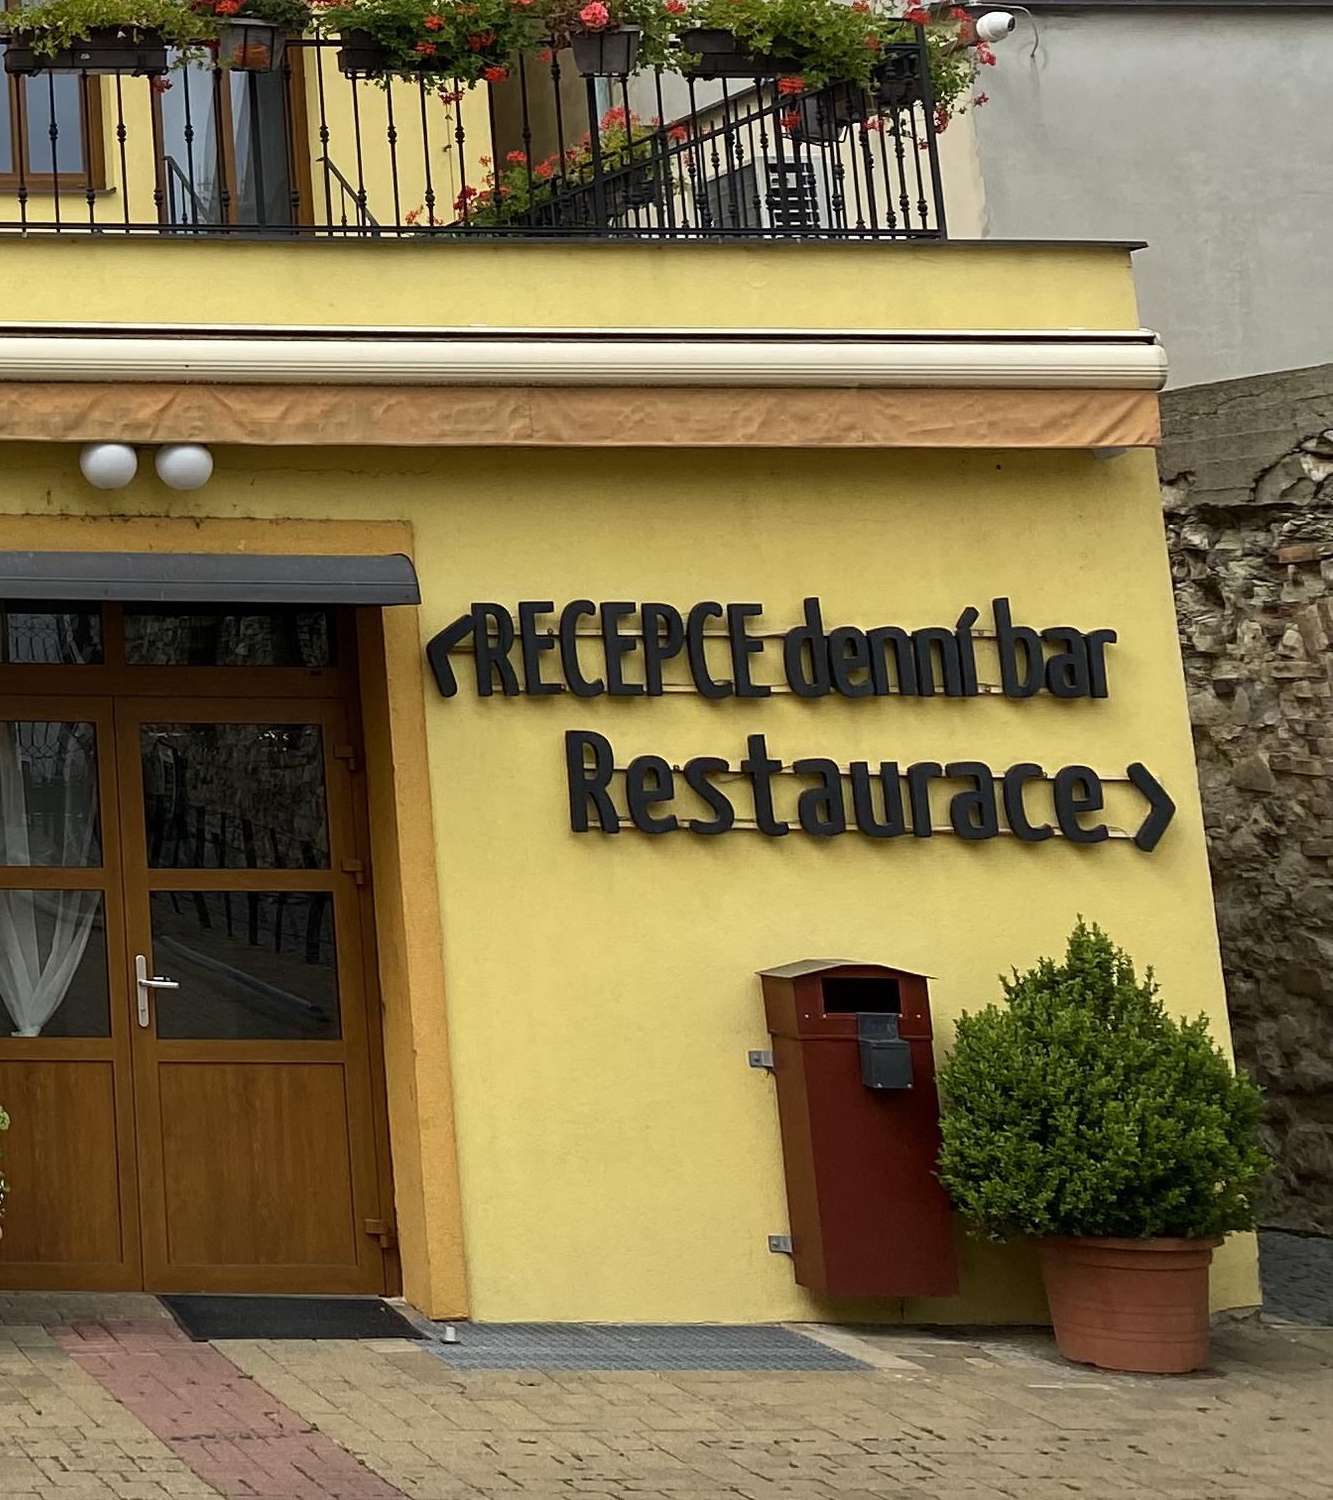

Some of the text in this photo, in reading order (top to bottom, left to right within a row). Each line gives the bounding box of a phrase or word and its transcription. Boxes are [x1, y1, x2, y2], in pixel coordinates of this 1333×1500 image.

[470, 597, 1117, 699] RECEPCE denní bar
[565, 729, 1108, 844] Restaurace
